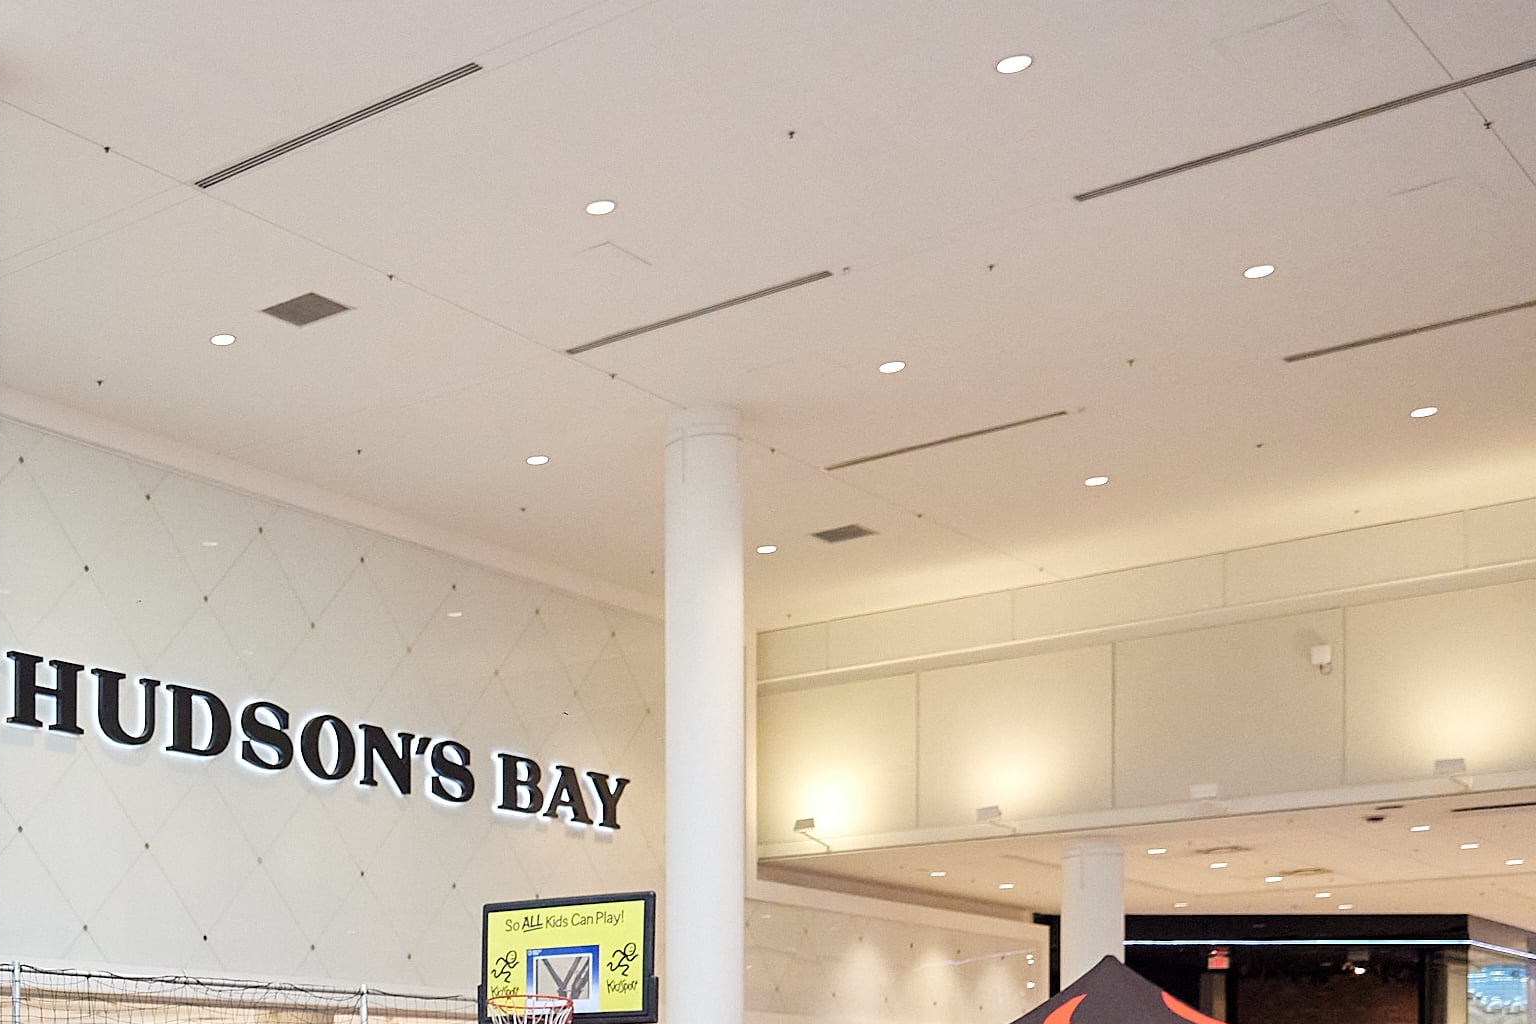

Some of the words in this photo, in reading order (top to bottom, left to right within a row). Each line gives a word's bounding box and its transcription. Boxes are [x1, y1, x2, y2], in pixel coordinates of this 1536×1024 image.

[7, 650, 475, 803] HUDSON'S
[496, 752, 630, 830] BAY
[505, 918, 520, 932] So
[521, 914, 543, 931] ALL
[545, 914, 569, 928] Kids
[571, 912, 594, 926] Can
[595, 909, 624, 927] Play!
[606, 979, 638, 994] KidSport
